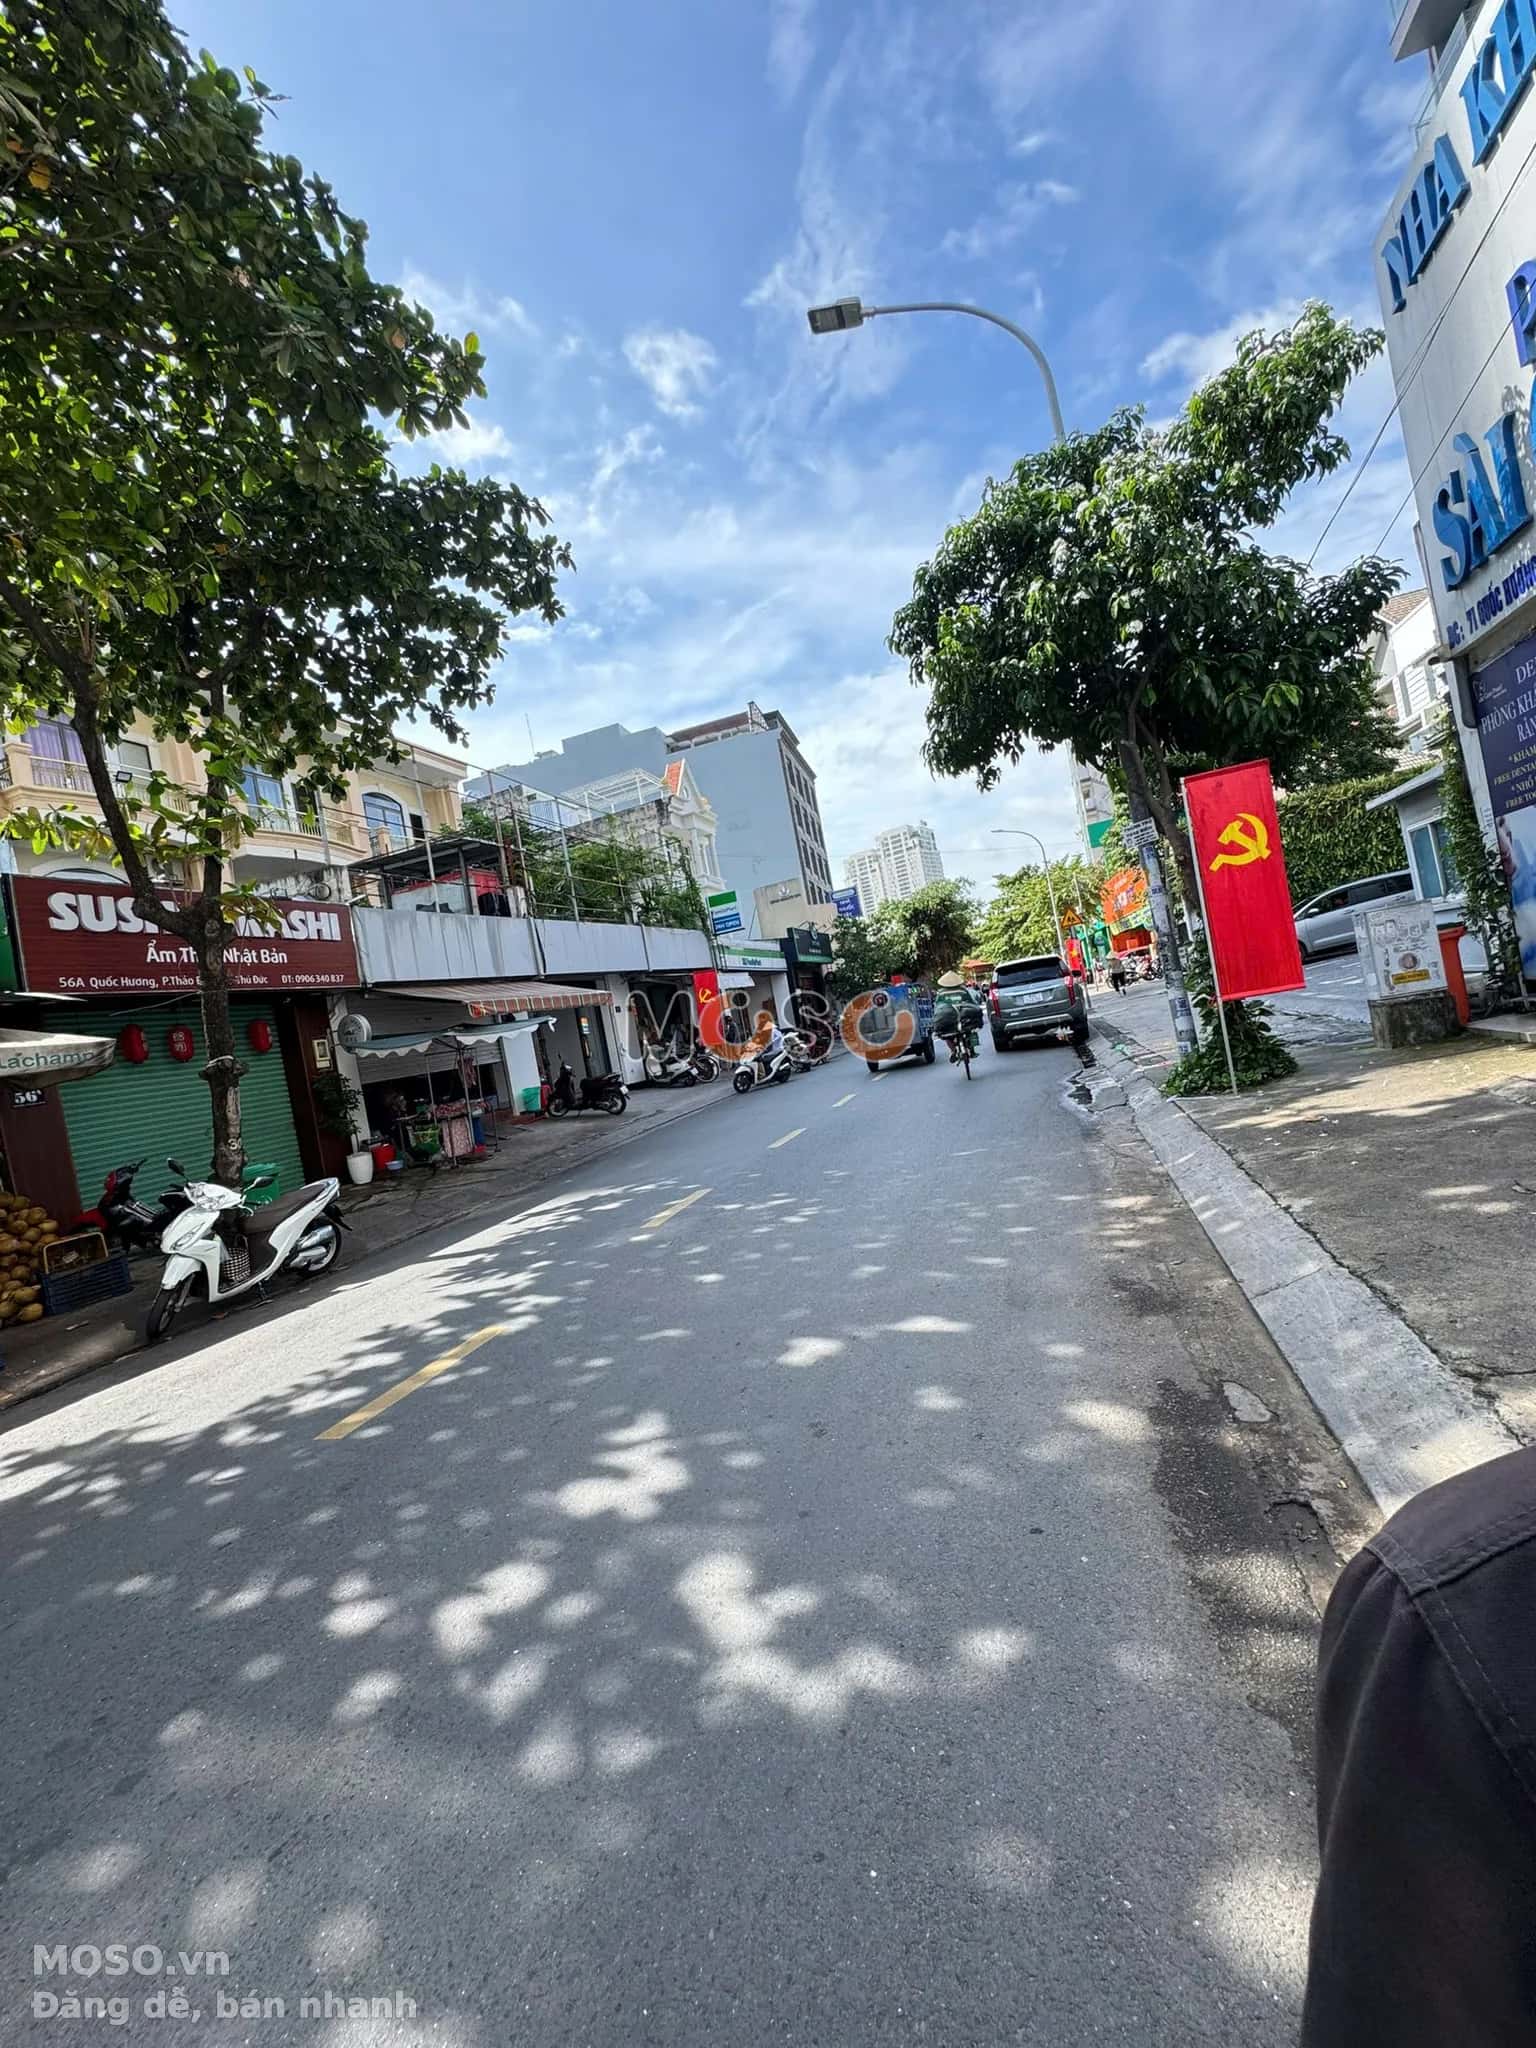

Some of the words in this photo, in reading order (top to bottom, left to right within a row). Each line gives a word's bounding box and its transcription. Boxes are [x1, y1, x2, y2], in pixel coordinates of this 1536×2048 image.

[1516, 656, 1536, 684] DE
[223, 948, 258, 966] Nhật
[261, 948, 288, 964] Bản
[59, 978, 86, 988] 56A
[89, 976, 119, 987] Quốc
